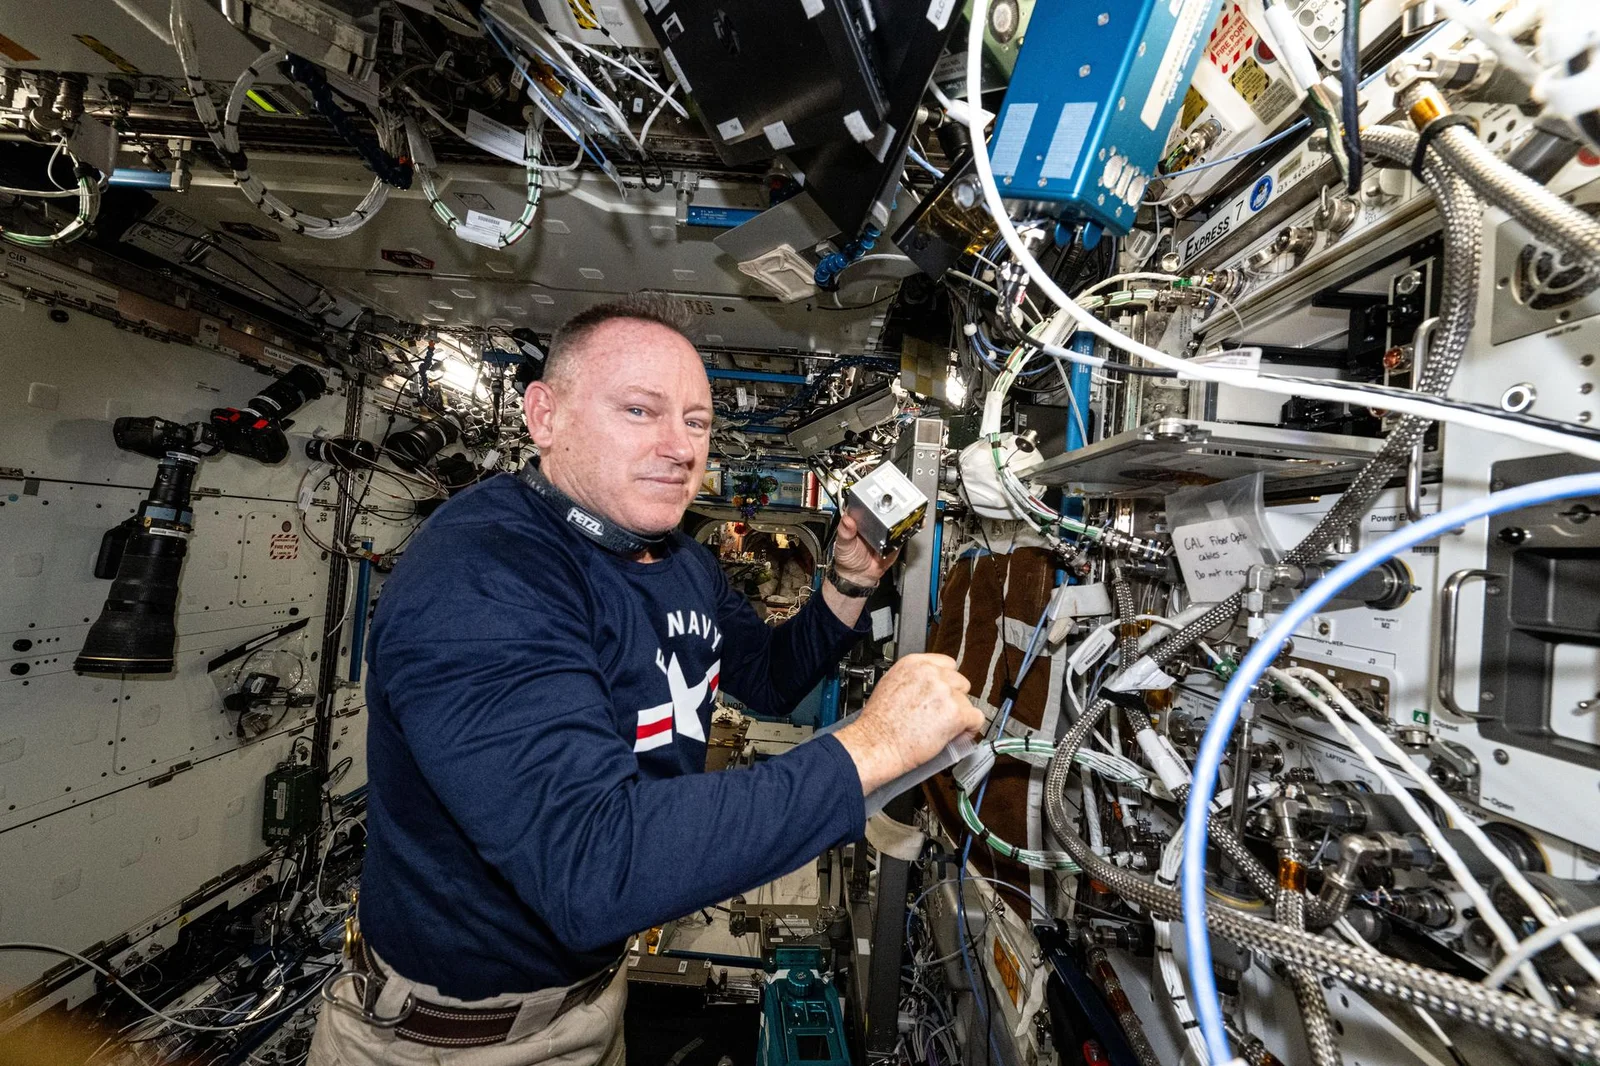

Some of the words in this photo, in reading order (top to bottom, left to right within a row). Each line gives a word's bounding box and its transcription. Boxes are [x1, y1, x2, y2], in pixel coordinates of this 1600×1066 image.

[1215, 39, 1232, 58] FIRE
[1229, 20, 1248, 42] PORT
[1234, 64, 1254, 84] CAUTION
[1235, 200, 1245, 222] 7
[8, 251, 27, 264] CIR
[566, 507, 603, 536] PETZL
[1371, 514, 1397, 522] Power
[1184, 537, 1204, 550] CAL
[1209, 535, 1228, 546] Fiber
[1194, 569, 1206, 580] Do
[1208, 568, 1221, 577] not
[666, 609, 722, 652] NAVY
[1432, 719, 1460, 732] Closed
[1490, 797, 1515, 811] Open
